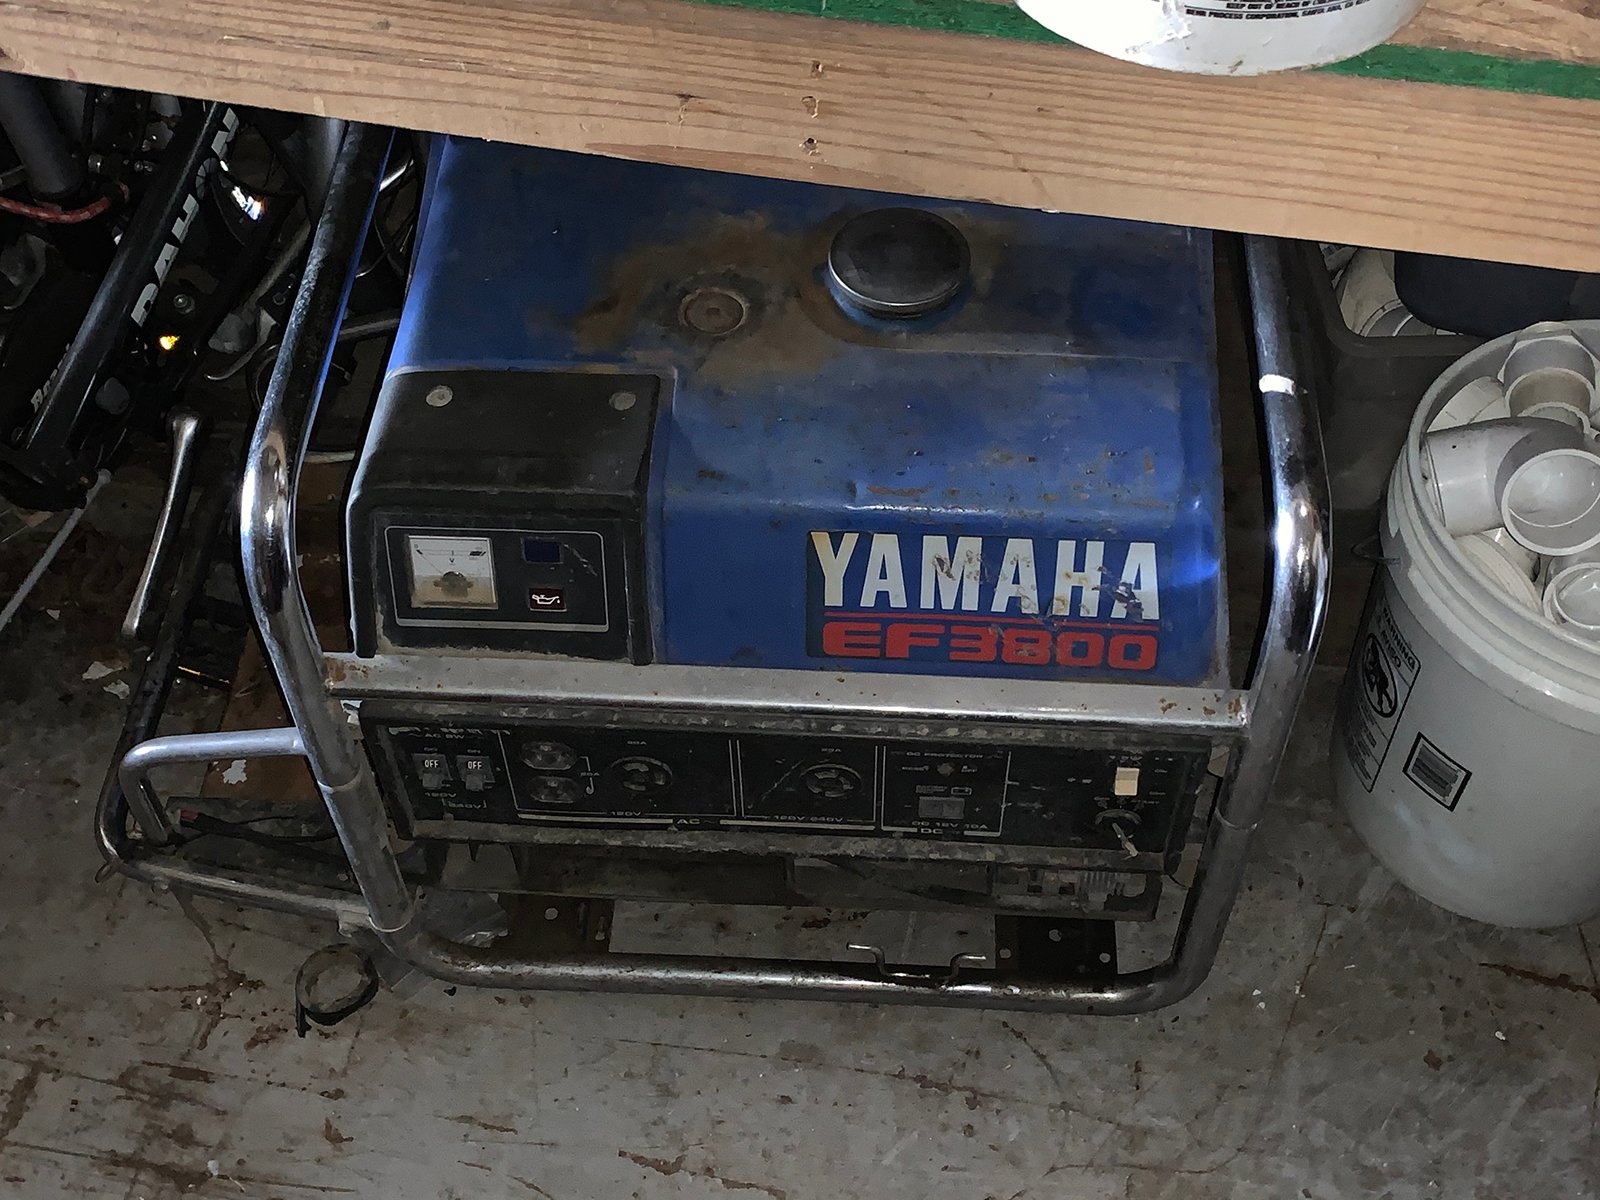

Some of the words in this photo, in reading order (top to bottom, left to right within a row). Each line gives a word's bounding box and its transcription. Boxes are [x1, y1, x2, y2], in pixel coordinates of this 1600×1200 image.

[811, 531, 1160, 620] YAMAHA
[822, 621, 1158, 671] EF3800
[424, 759, 439, 768] OFF
[467, 760, 483, 770] OFF
[920, 827, 943, 835] DC
